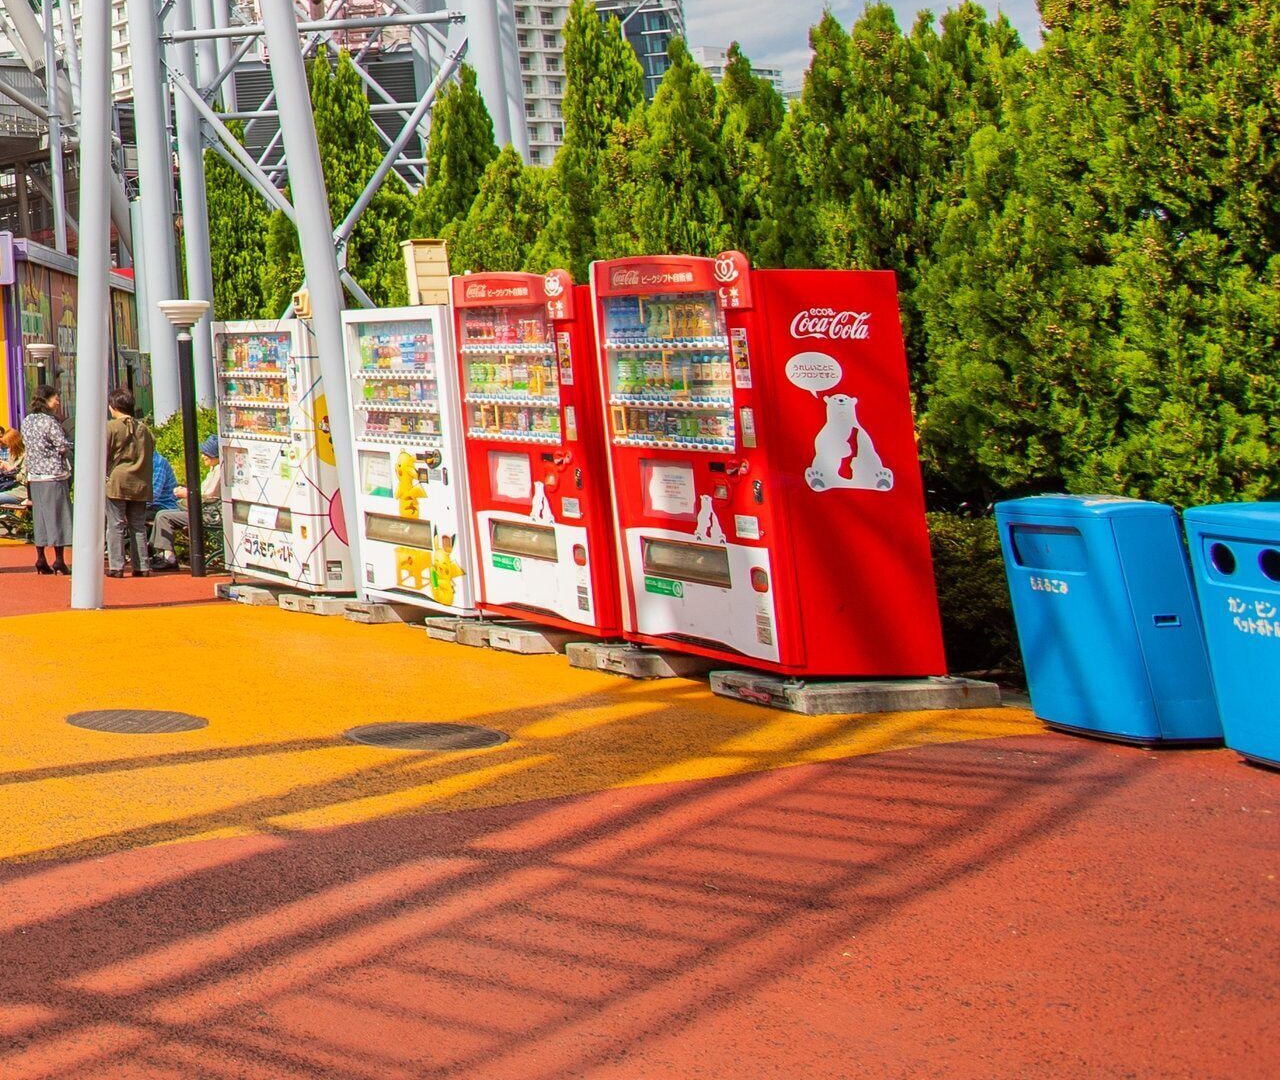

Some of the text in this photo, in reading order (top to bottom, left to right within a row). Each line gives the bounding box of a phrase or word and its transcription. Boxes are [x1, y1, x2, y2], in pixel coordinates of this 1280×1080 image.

[790, 310, 872, 339] Coca-Cola
[1030, 576, 1068, 595] もえるごみ
